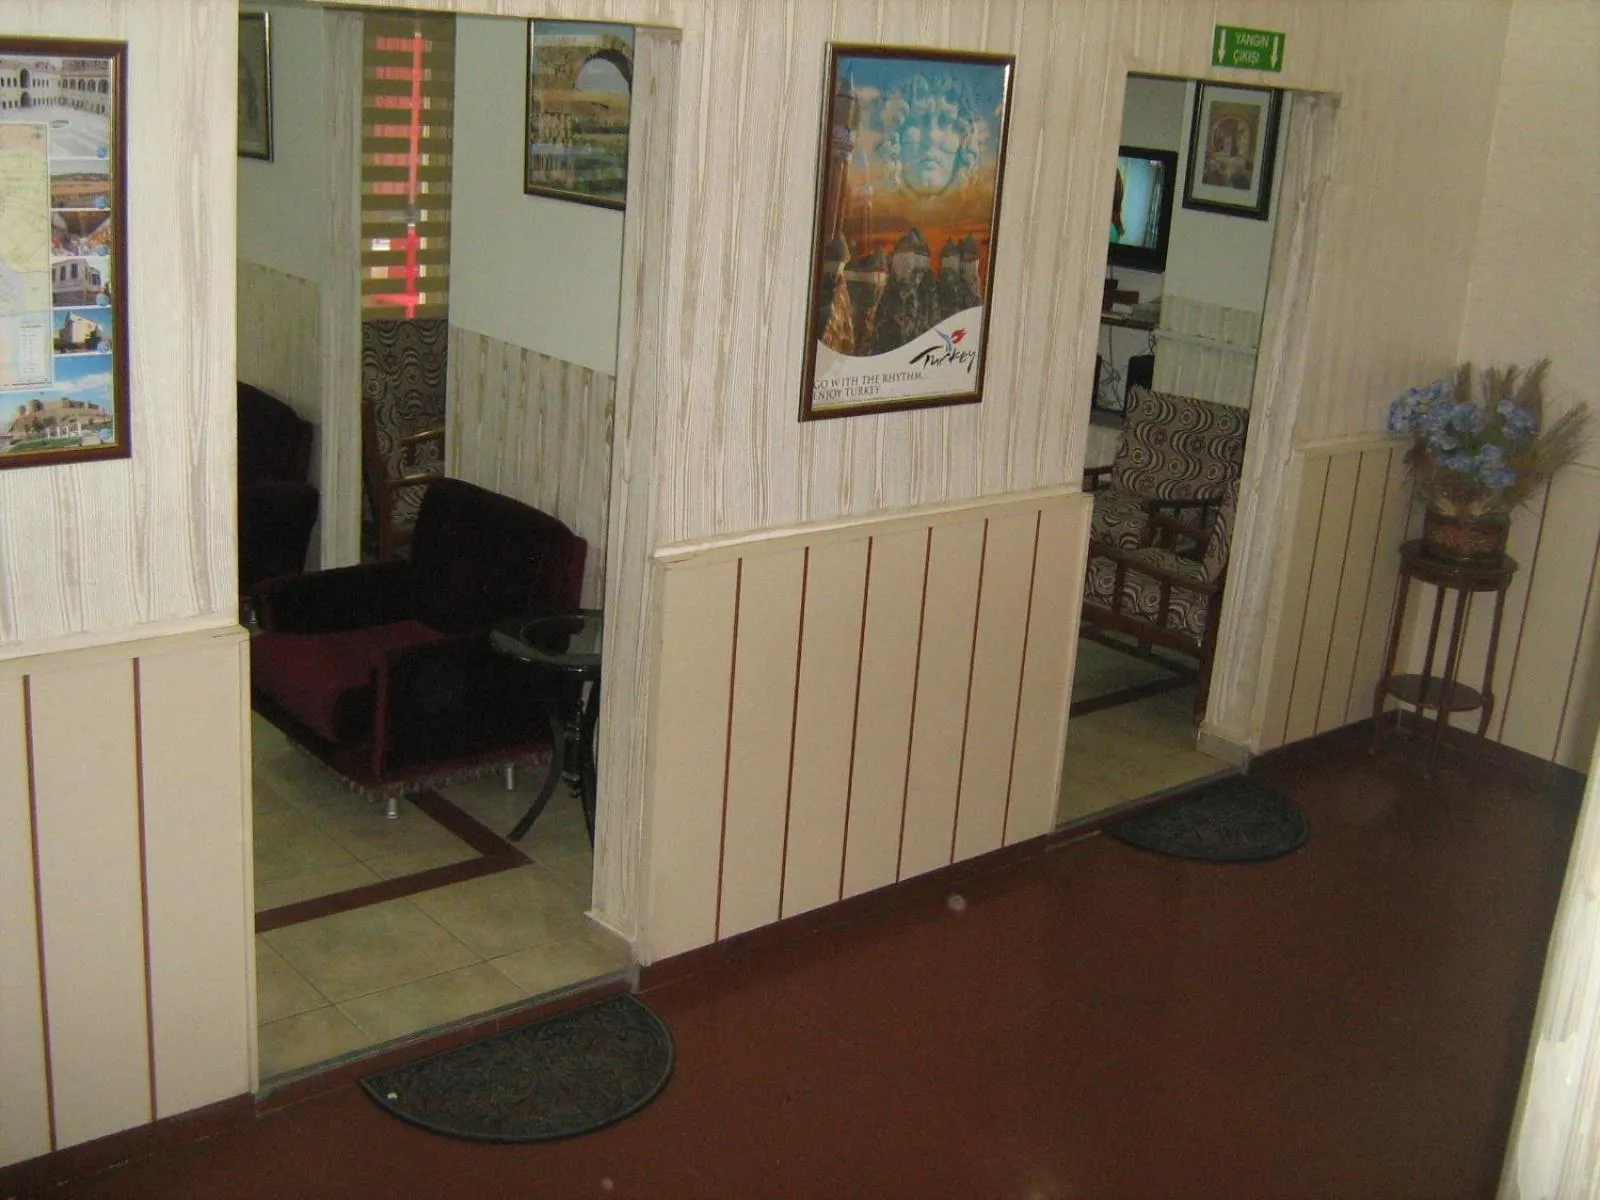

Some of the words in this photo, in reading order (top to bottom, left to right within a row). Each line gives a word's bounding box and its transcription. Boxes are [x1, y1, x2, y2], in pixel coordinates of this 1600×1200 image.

[1235, 32, 1270, 48] YANGIN
[909, 346, 976, 373] Turkey
[813, 377, 829, 389] GO
[831, 376, 859, 387] WITH
[861, 374, 880, 385] THE
[845, 385, 881, 397] TURKEY
